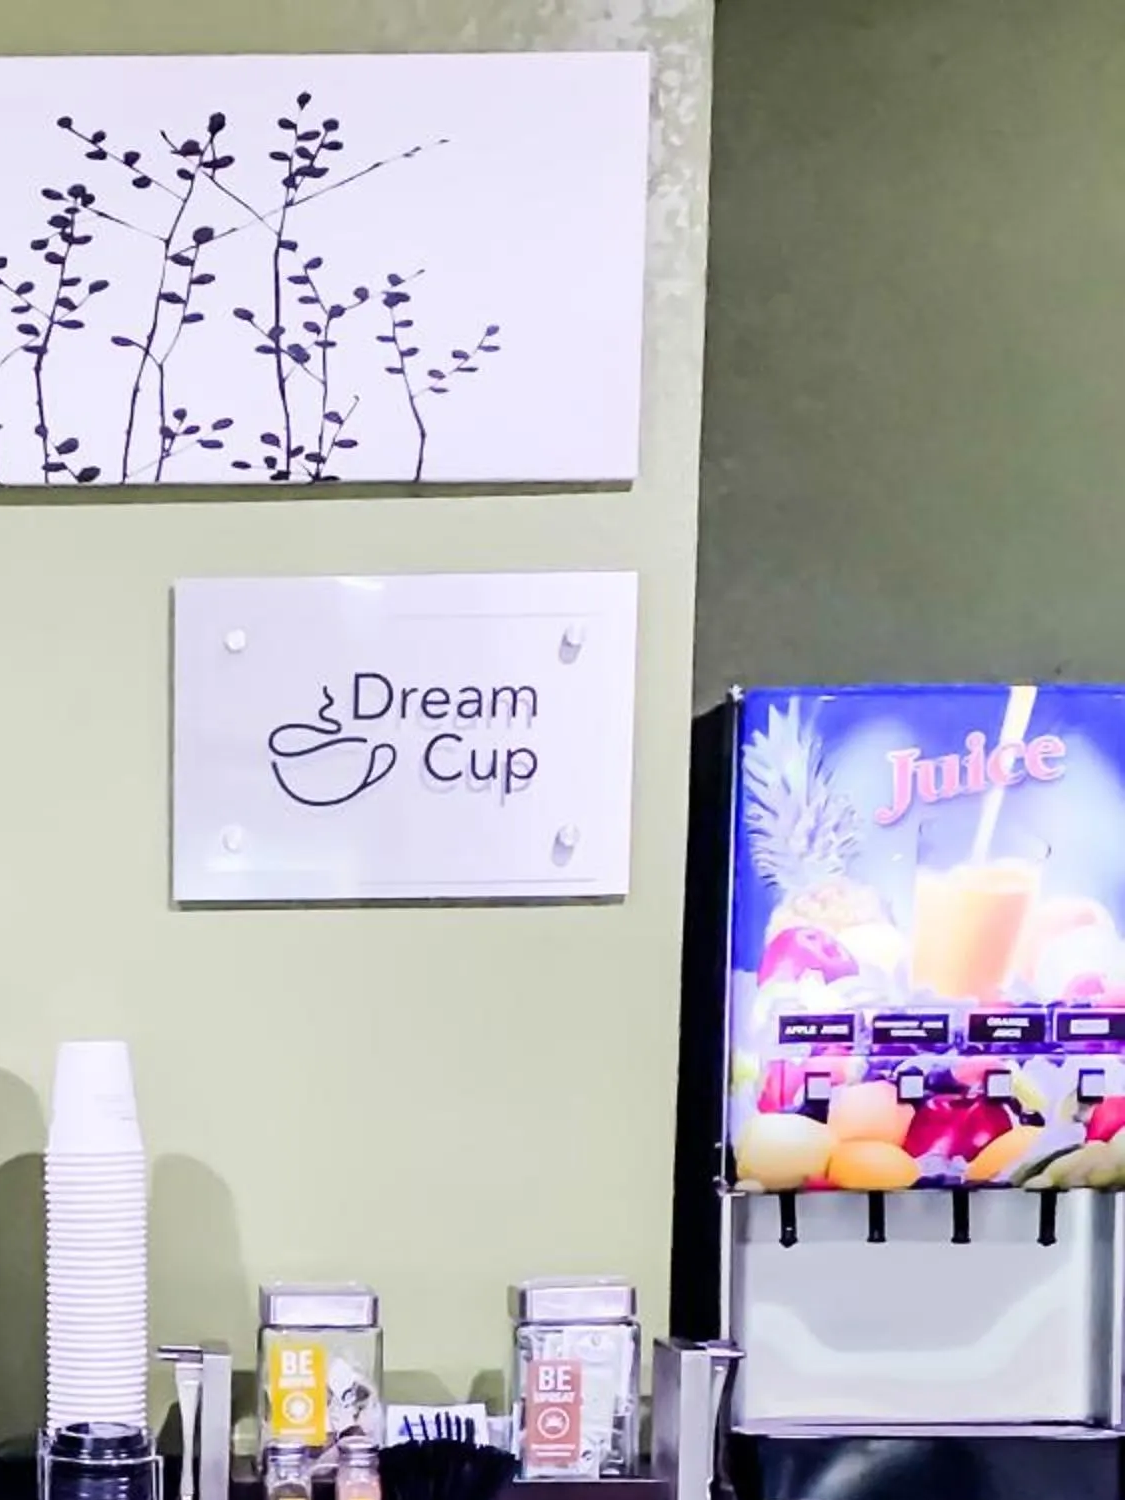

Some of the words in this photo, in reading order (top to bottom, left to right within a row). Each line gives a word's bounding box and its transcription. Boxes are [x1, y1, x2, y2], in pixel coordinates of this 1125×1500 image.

[353, 672, 538, 721] Dream
[423, 733, 539, 795] Cup
[875, 731, 1067, 825] Juice
[281, 1349, 315, 1375] BE
[538, 1365, 572, 1391] BE
